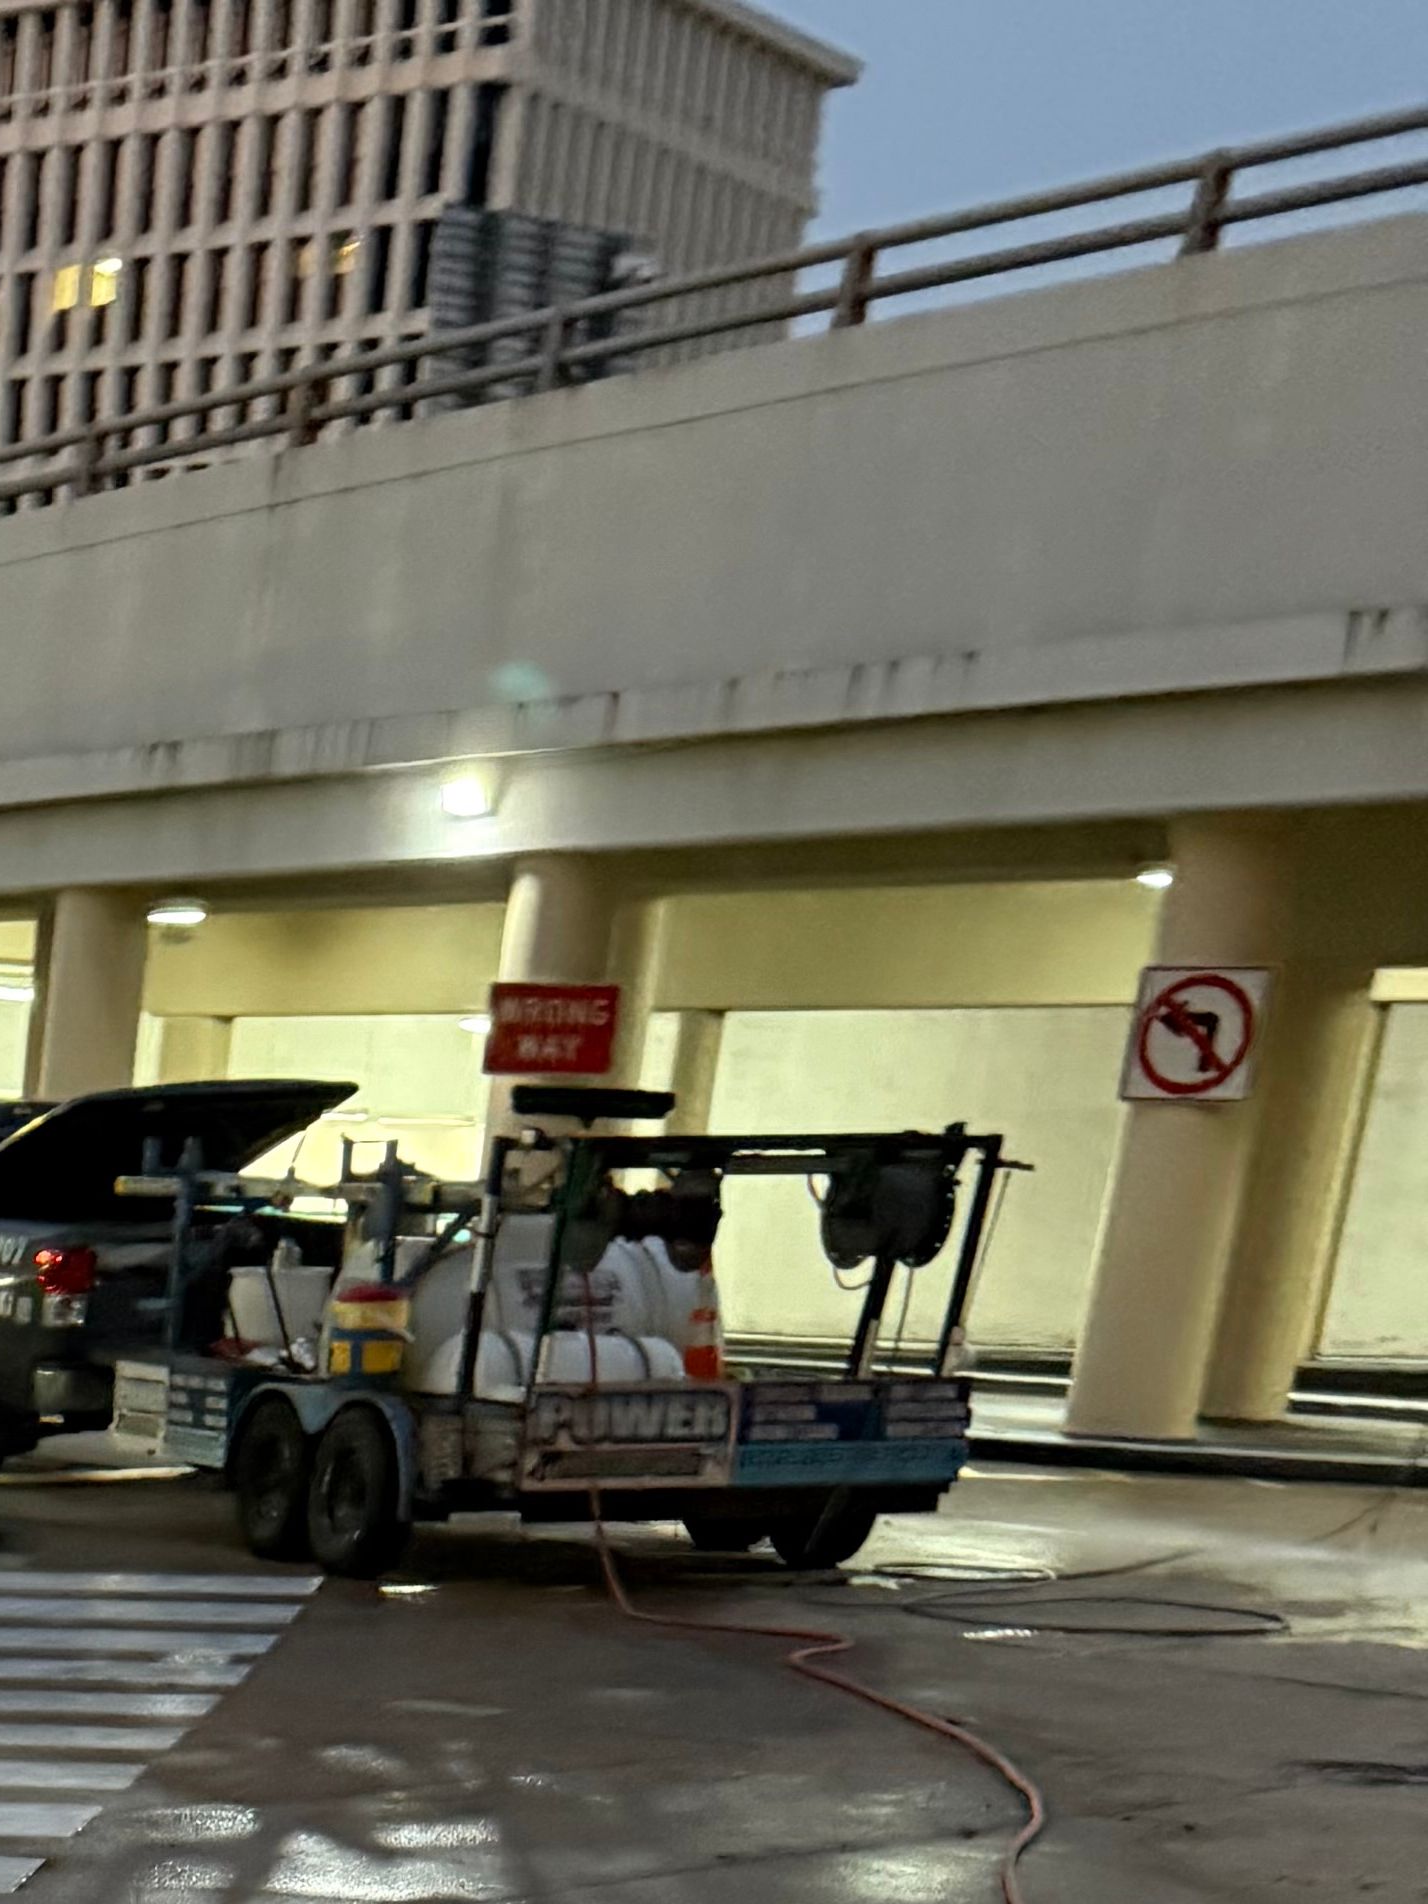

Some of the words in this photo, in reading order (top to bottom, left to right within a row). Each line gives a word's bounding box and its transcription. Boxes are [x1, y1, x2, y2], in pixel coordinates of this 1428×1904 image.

[498, 998, 610, 1025] WRONG
[518, 1034, 582, 1060] WAY
[524, 1393, 729, 1443] POWER
